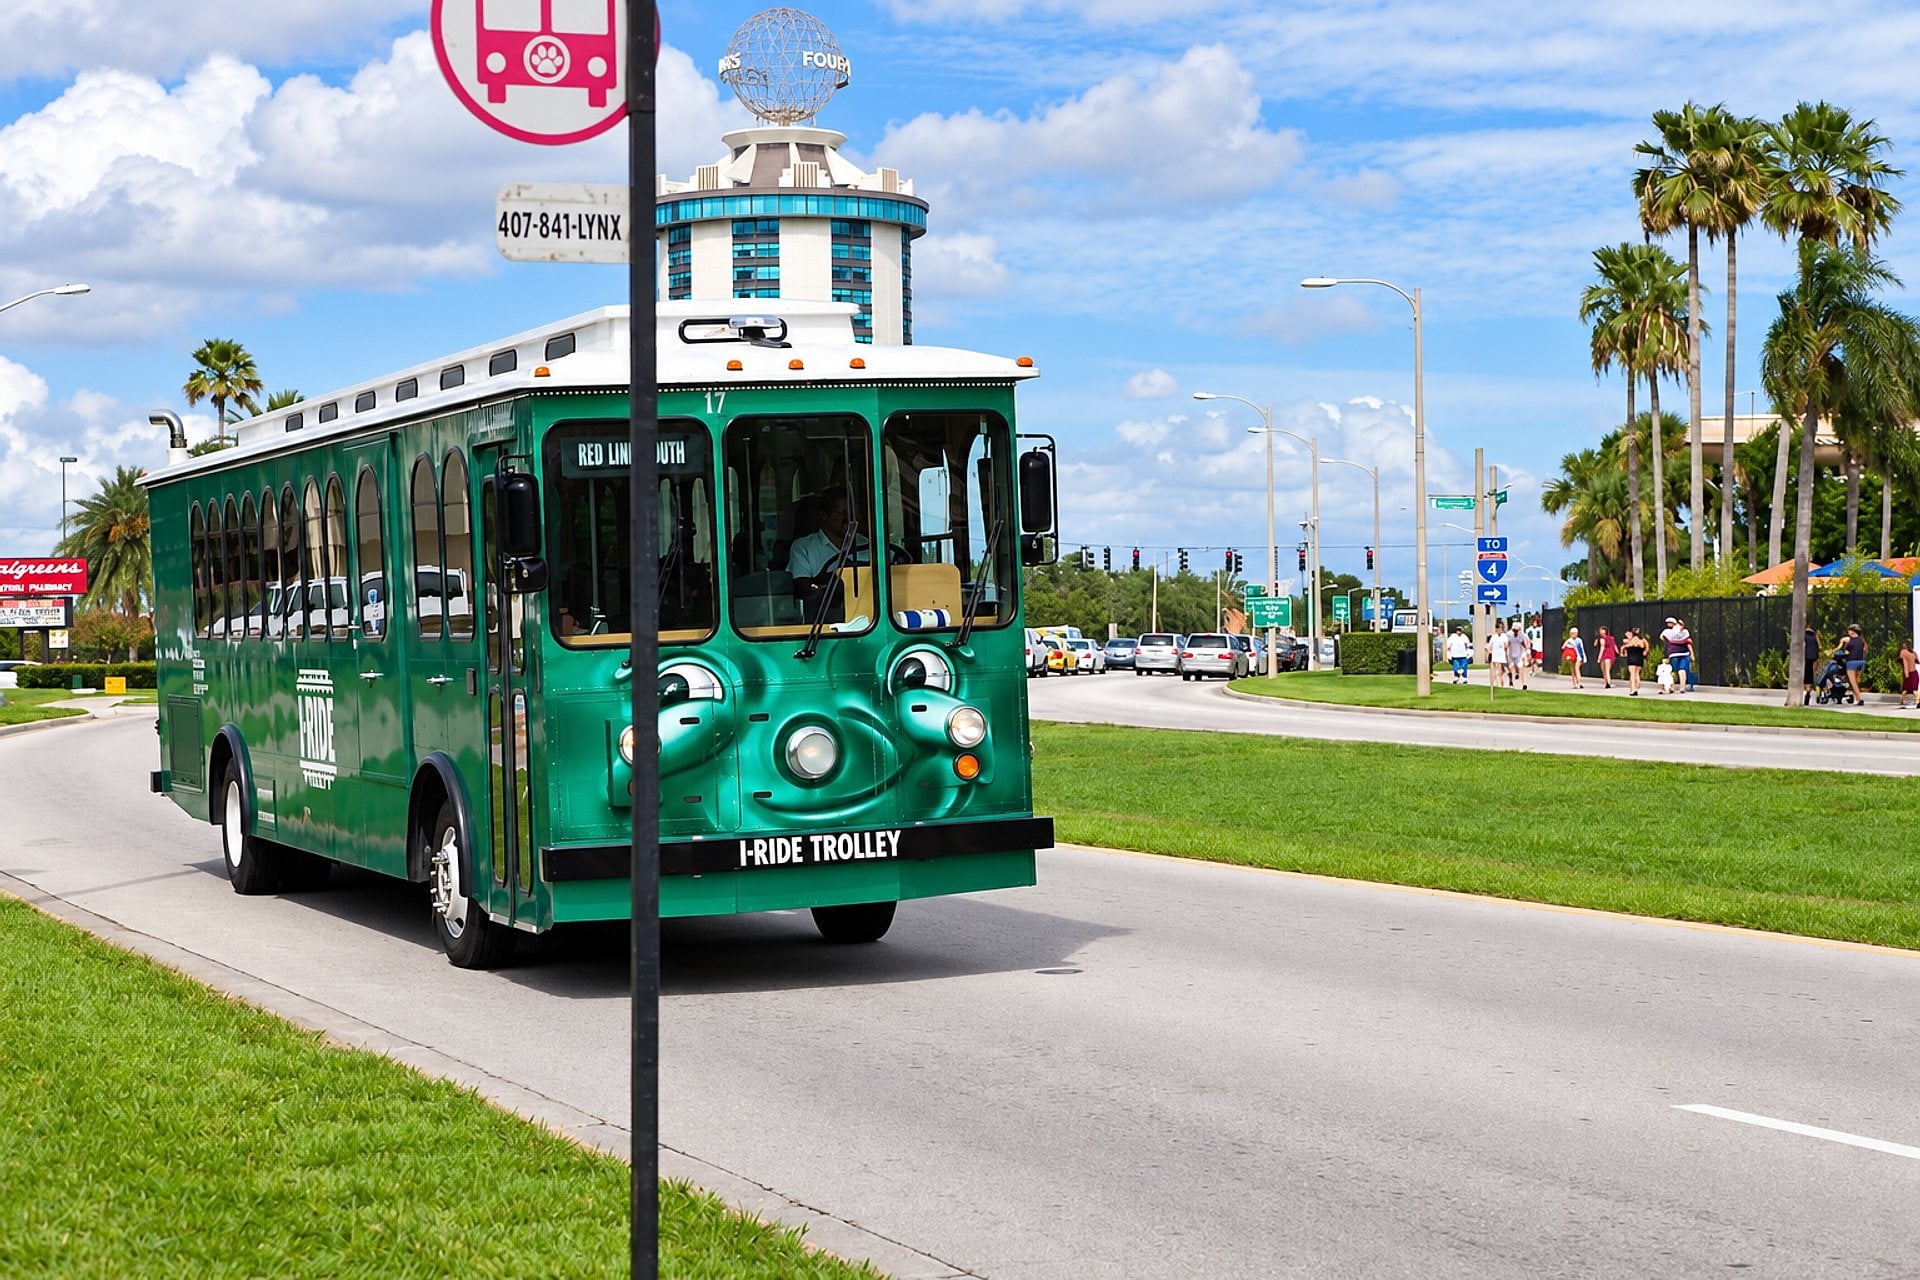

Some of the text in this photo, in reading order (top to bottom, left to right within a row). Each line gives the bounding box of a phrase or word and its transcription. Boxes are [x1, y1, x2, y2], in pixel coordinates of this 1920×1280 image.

[498, 211, 621, 241] 407-841-LYNX
[704, 391, 726, 414] 17
[578, 440, 686, 467] RED LIN UTH
[1485, 539, 1500, 549] TO
[1486, 562, 1498, 577] 4
[297, 695, 336, 763] I-RIDE
[739, 830, 902, 867] I-RIDE TROLLEY
